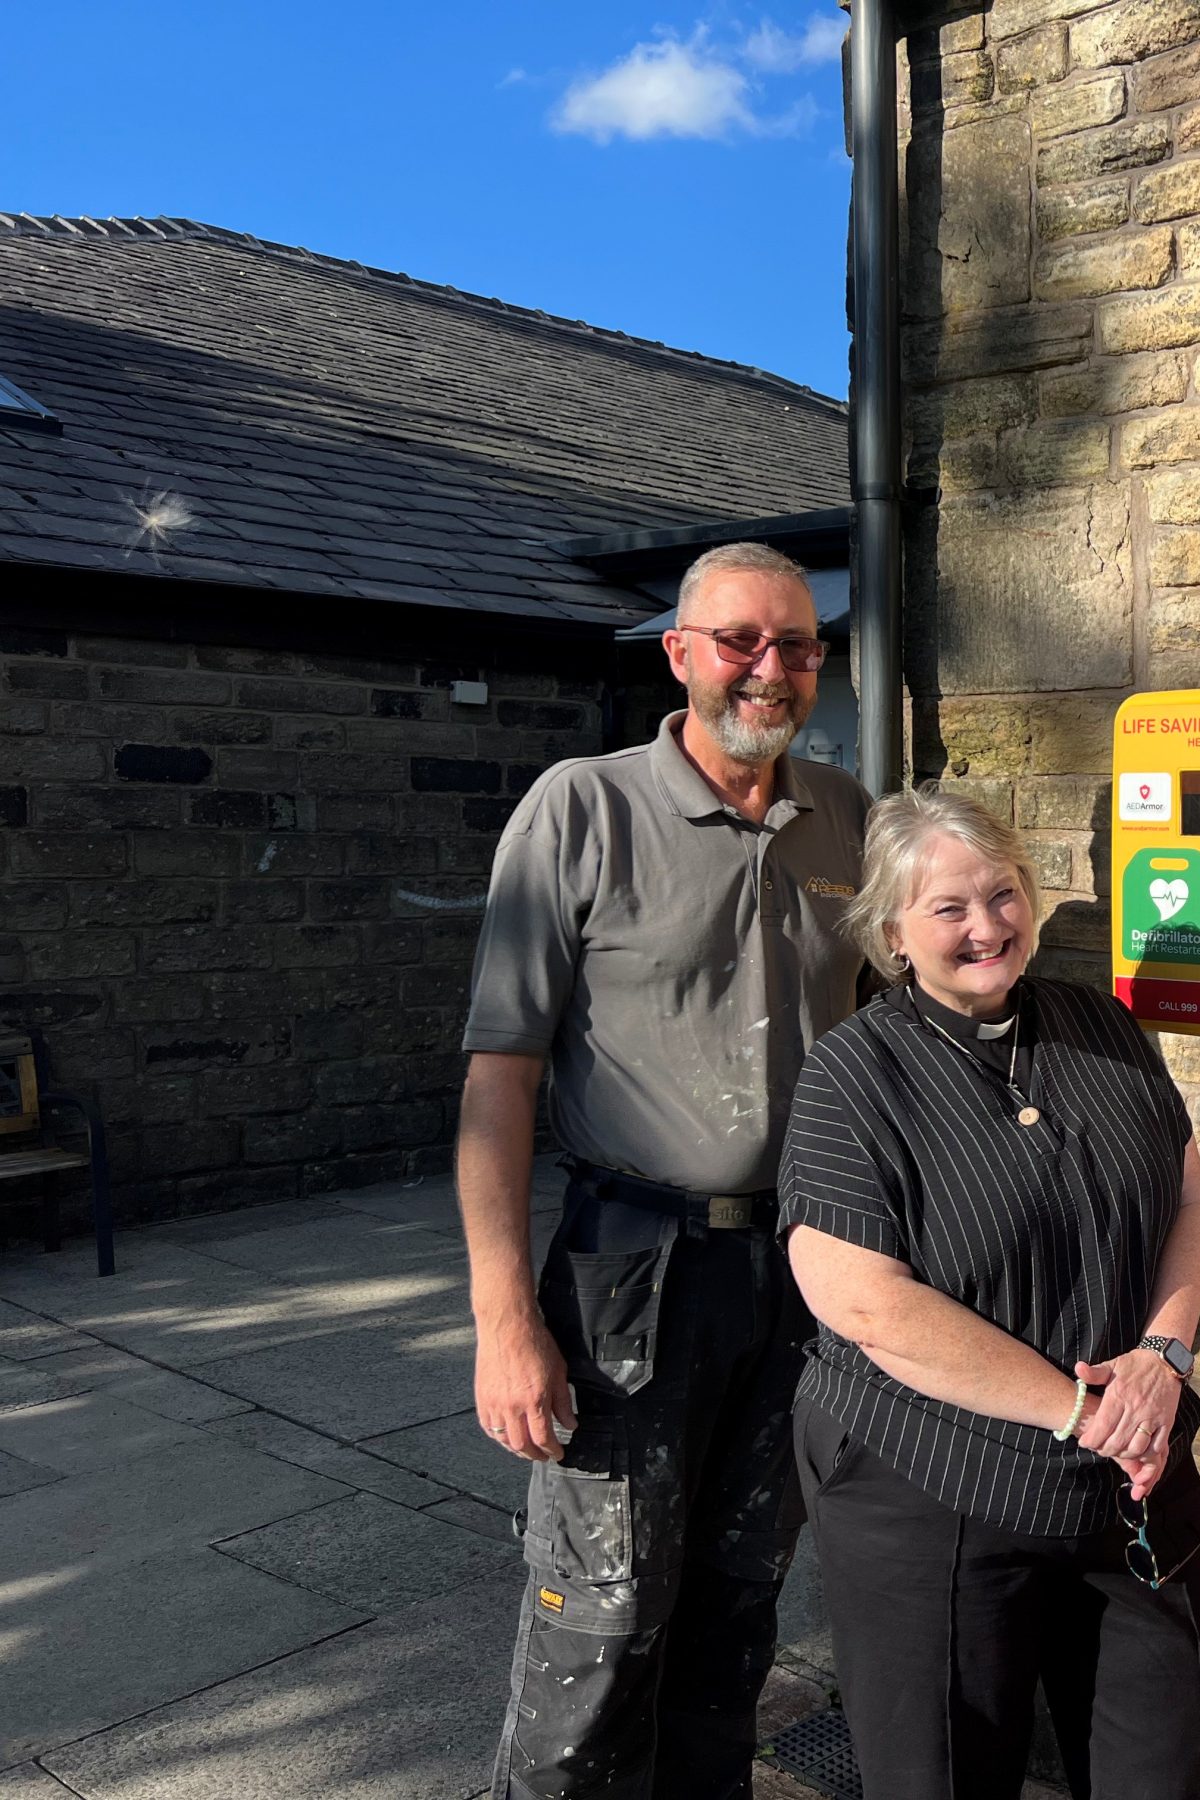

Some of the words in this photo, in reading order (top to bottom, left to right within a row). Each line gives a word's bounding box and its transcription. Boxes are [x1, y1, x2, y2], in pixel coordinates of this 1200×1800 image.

[1123, 719, 1156, 734] LIFE
[1126, 802, 1163, 810] AEDArmor
[1131, 941, 1159, 953] Heart
[1158, 1001, 1179, 1011] CALL
[1181, 1002, 1198, 1012] 999
